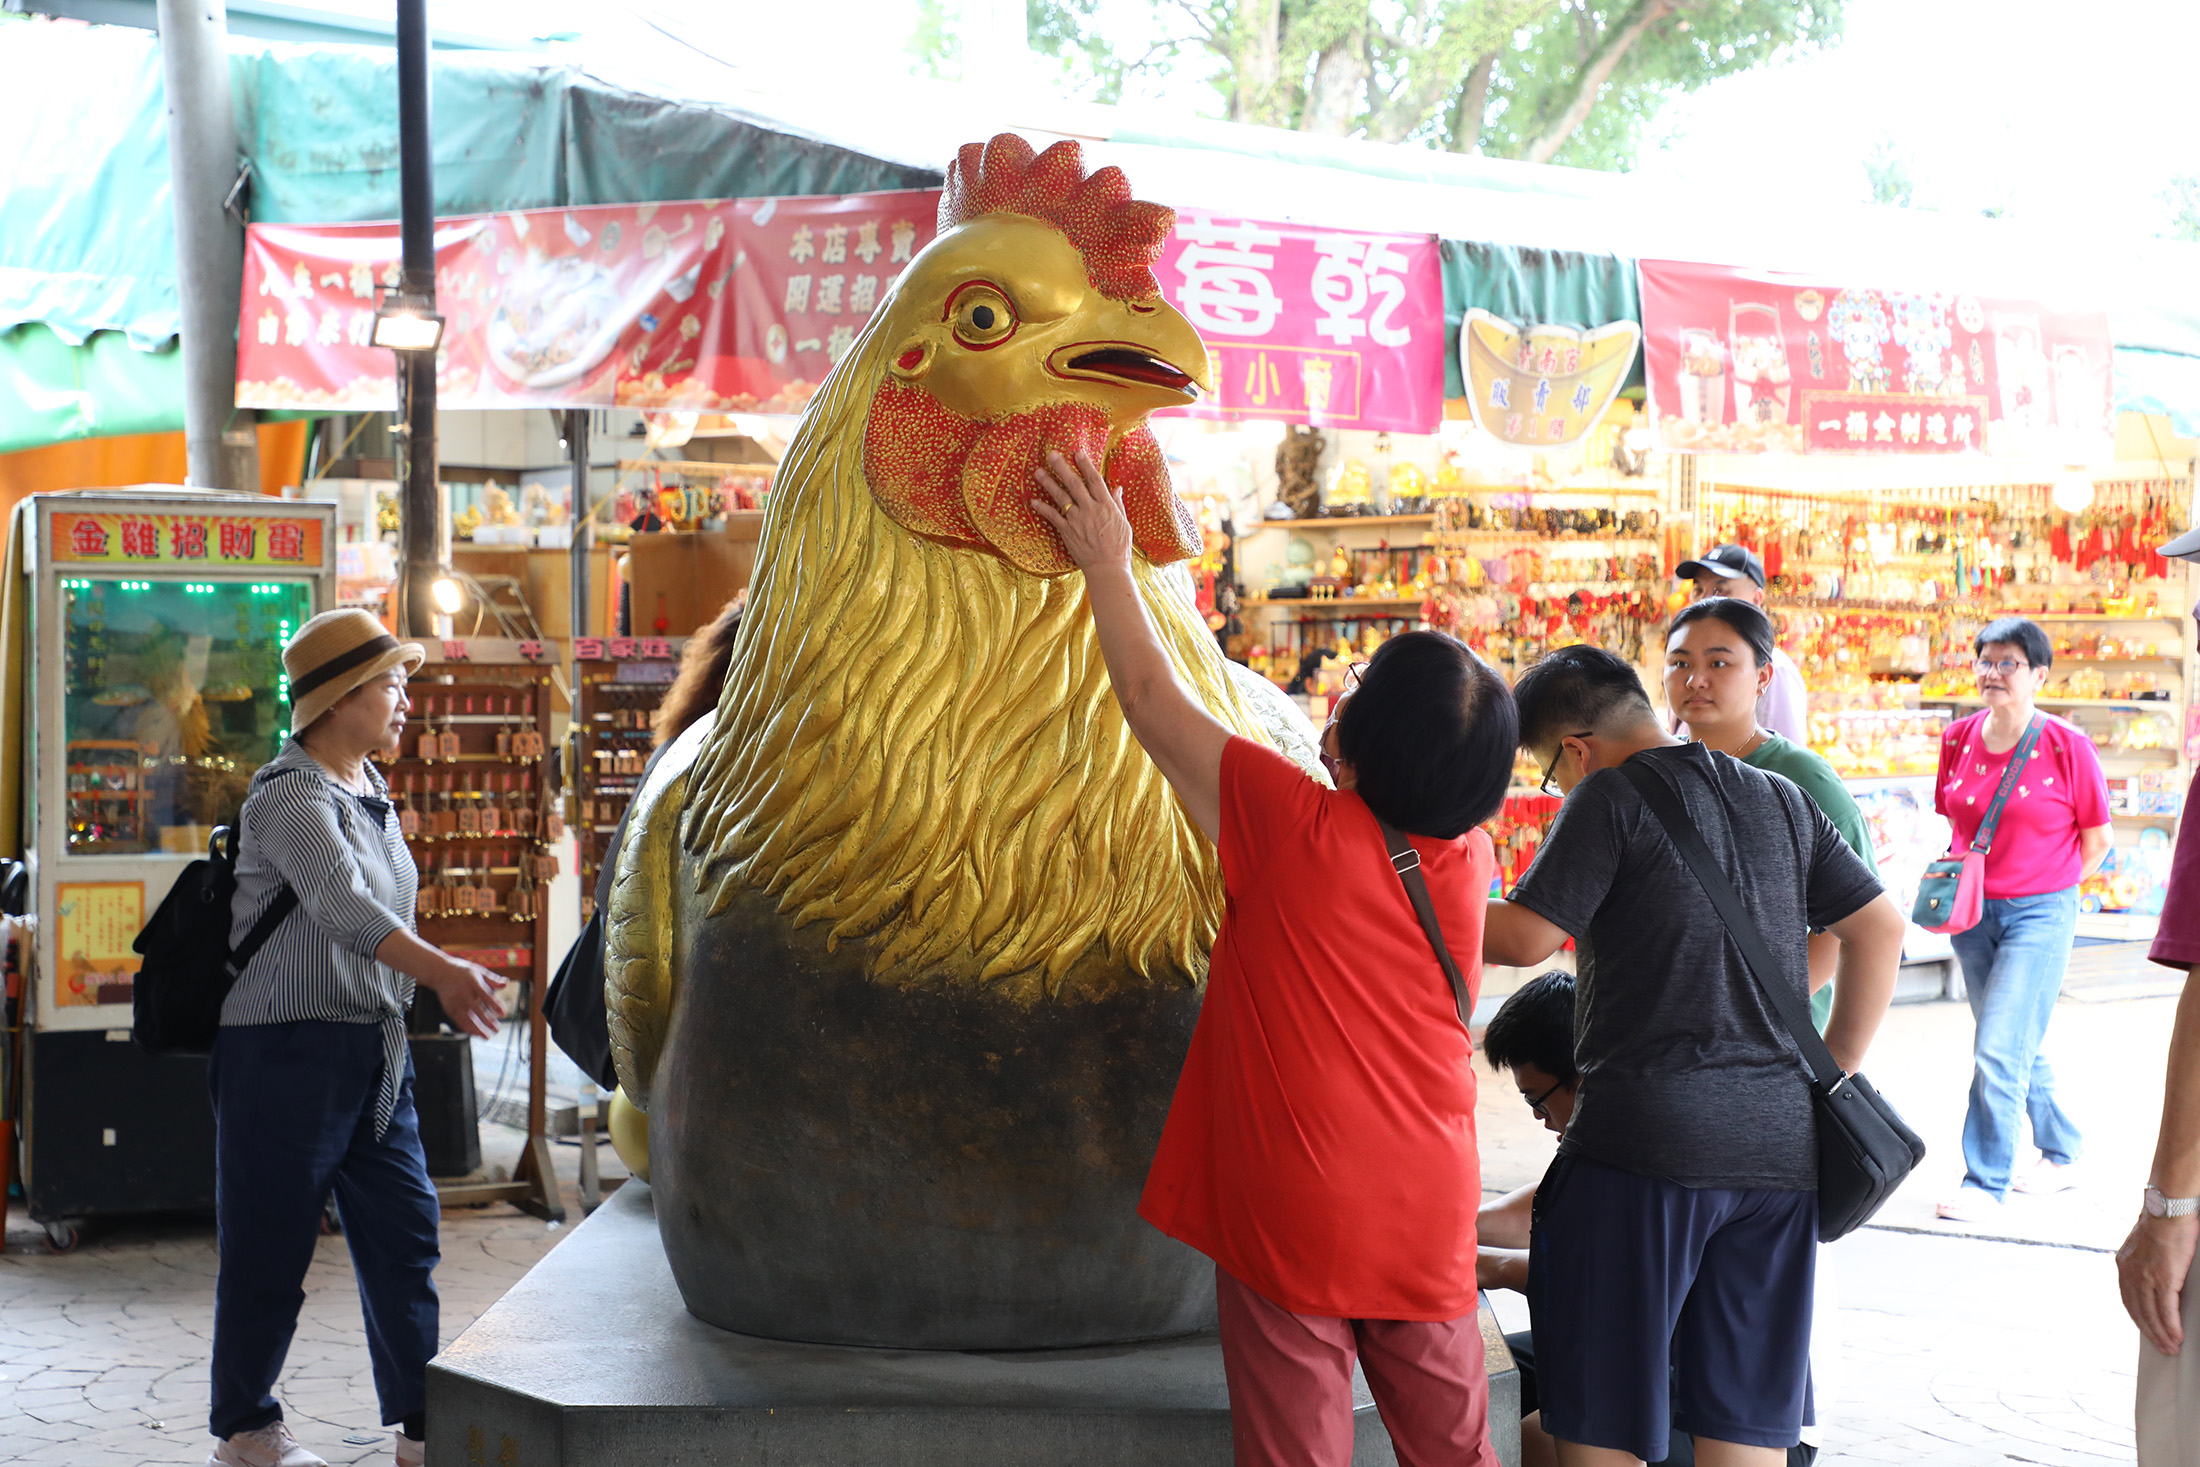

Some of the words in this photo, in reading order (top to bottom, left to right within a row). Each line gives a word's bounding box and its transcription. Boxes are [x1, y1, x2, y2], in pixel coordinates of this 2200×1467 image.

[1175, 216, 1412, 348] 莓乾
[71, 519, 304, 561] 金雞招財蛋
[575, 636, 672, 660] 百家姓
[1998, 757, 2024, 798] GOODS
